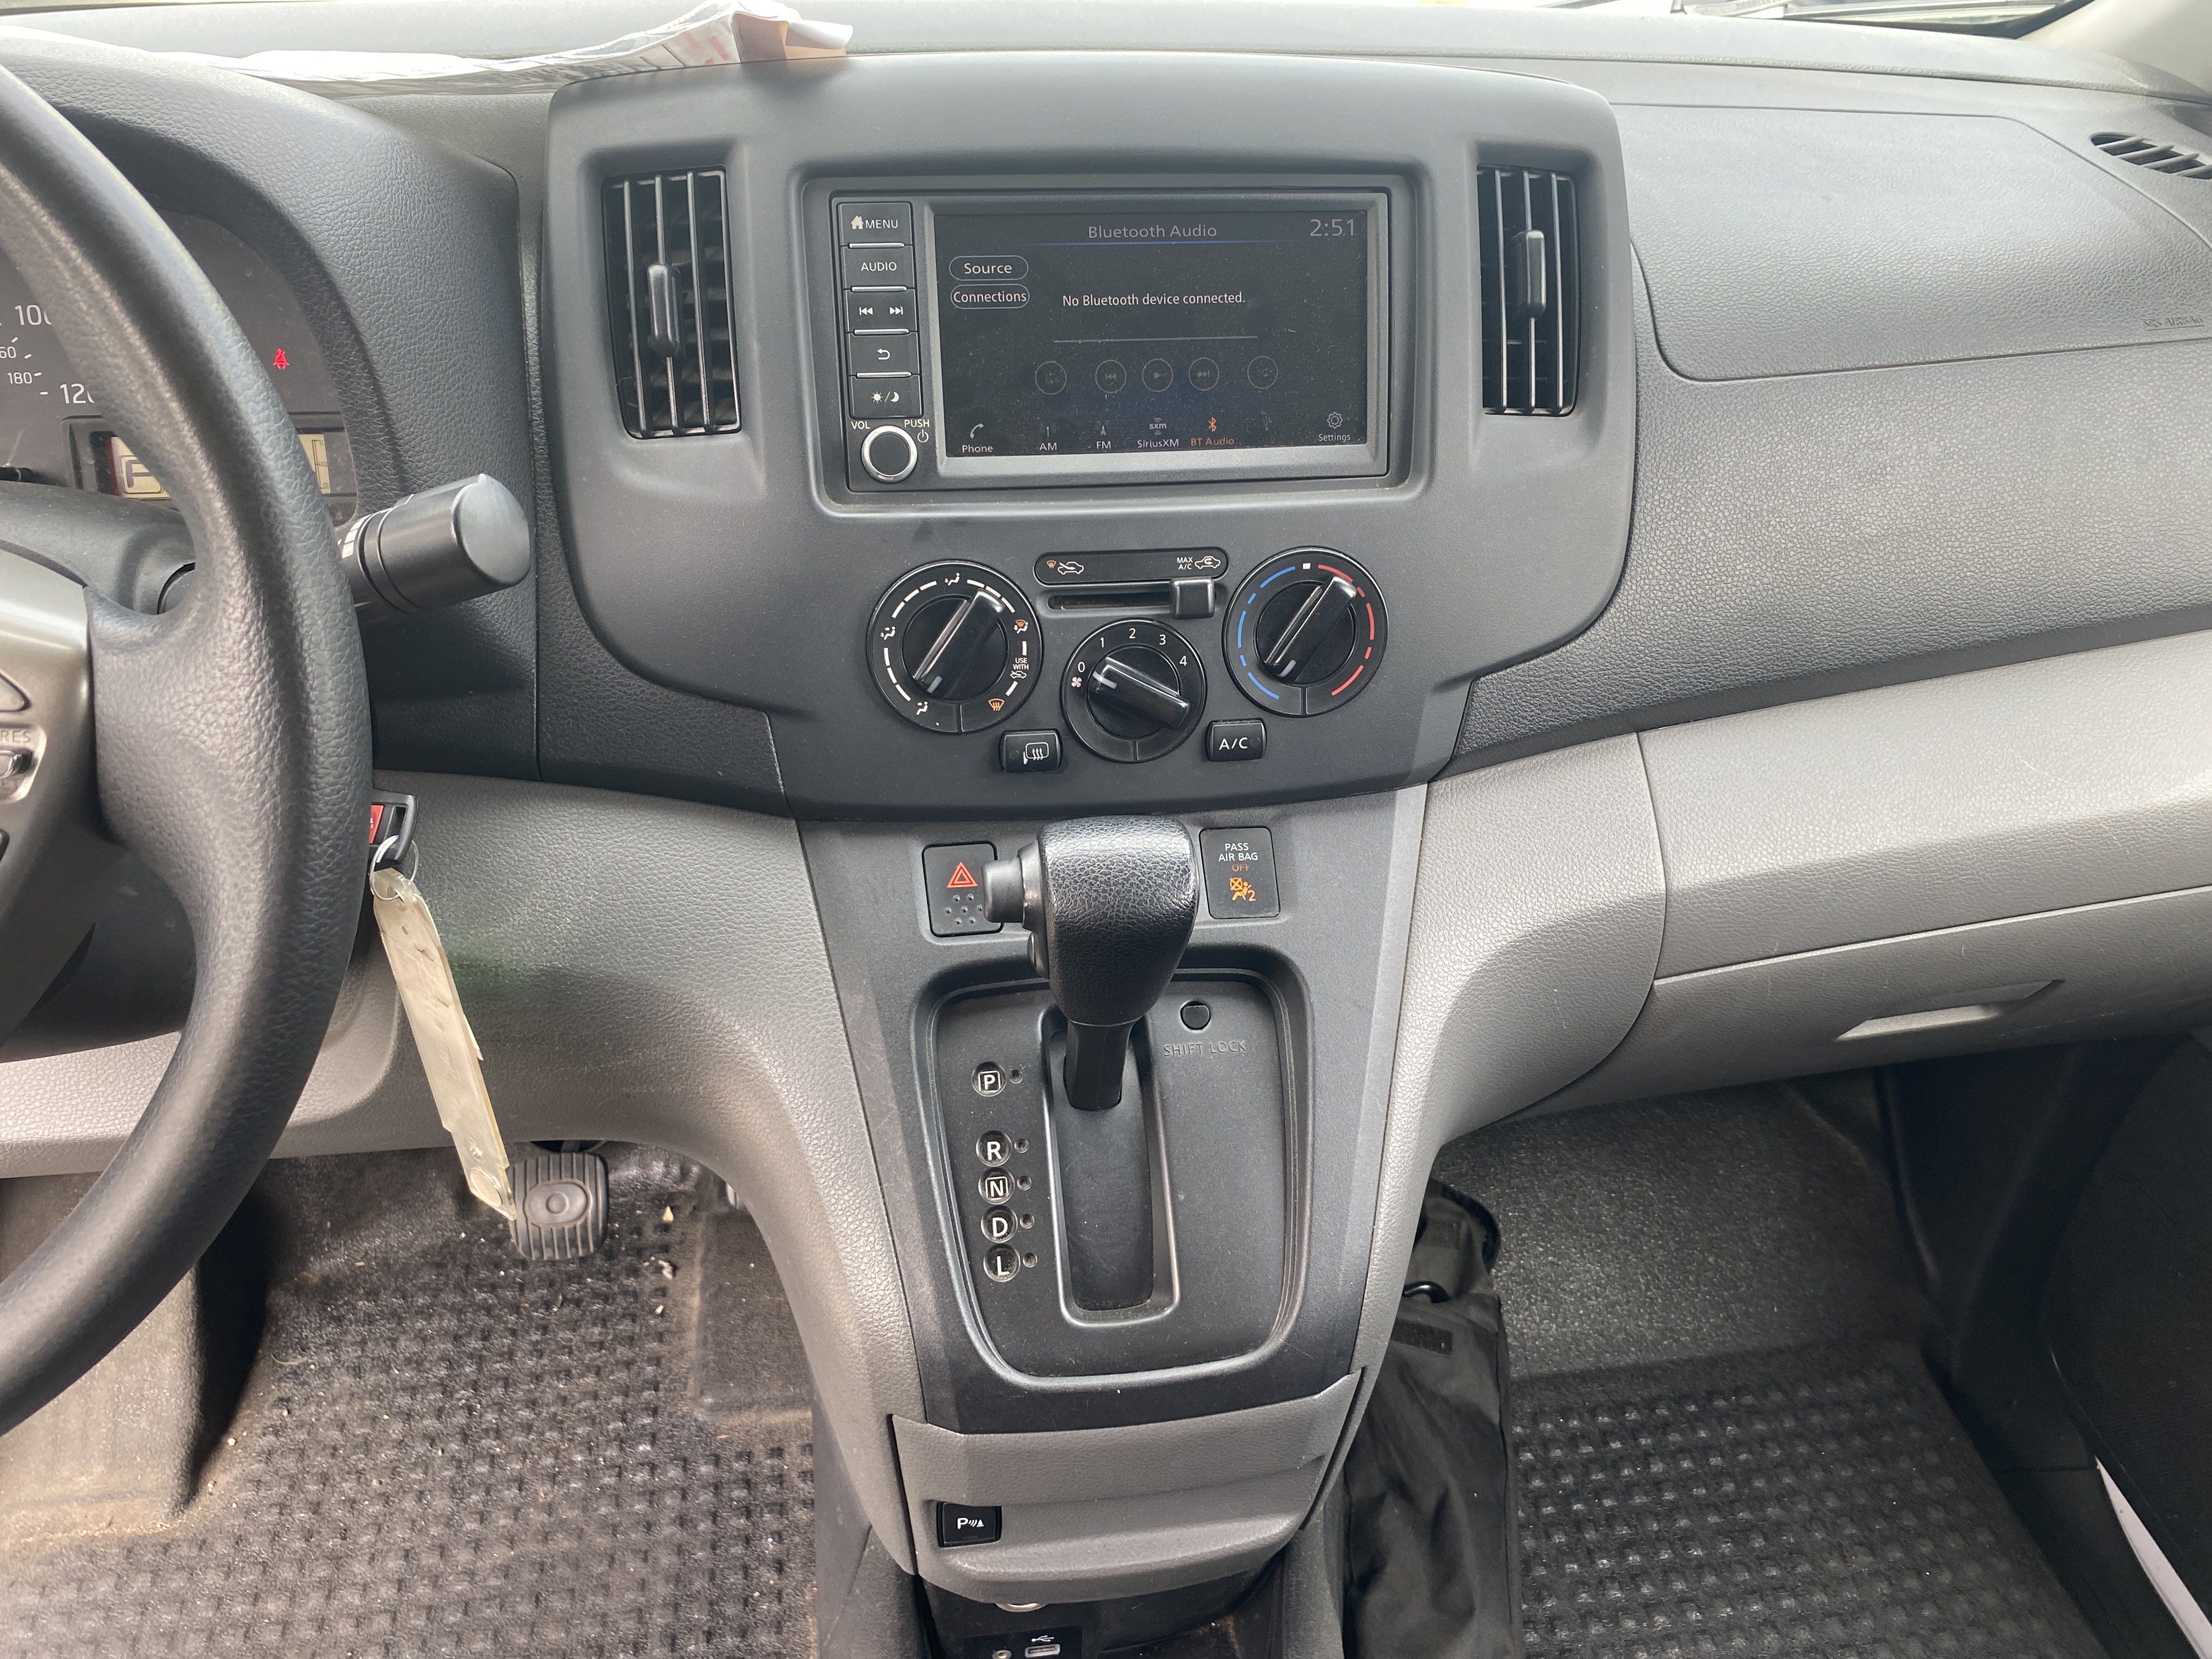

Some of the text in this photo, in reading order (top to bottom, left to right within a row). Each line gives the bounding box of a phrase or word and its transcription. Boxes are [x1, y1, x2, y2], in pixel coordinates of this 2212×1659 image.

[865, 219, 899, 229] MENU
[1310, 219, 1354, 236] 2:51
[1088, 224, 1217, 238] Bluetooth Audio
[861, 261, 897, 272] AUDIO
[964, 263, 1013, 275] Source
[953, 291, 1027, 304] Connections
[1063, 292, 1246, 307] No Bluetooth device connected.
[15, 304, 52, 325] 10
[7, 372, 33, 385] 180
[60, 383, 95, 404] 12
[851, 420, 870, 430] VOL
[904, 419, 930, 428] PUSH
[1137, 438, 1179, 448] SiriusXM
[1190, 437, 1234, 446] BT Audio
[1318, 433, 1351, 443] Settings
[962, 445, 994, 453] Phone
[1040, 442, 1057, 451] AM
[1096, 441, 1111, 449] FM
[1129, 628, 1136, 639] 2
[1099, 636, 1105, 647] 1
[1159, 634, 1166, 645] 3
[1180, 656, 1188, 666] 4
[1077, 662, 1086, 673] 0
[1219, 737, 1248, 750] A/C
[1224, 843, 1249, 851] PASS
[1218, 852, 1259, 861] AIR BAG
[1232, 863, 1251, 872] OFF
[1164, 1041, 1247, 1057] SHIFT LOCK
[984, 1074, 995, 1090] P
[987, 1142, 1002, 1160] R
[990, 1181, 1003, 1197] N
[992, 1217, 1008, 1237] D
[996, 1256, 1009, 1276] L
[957, 1517, 968, 1529] P
